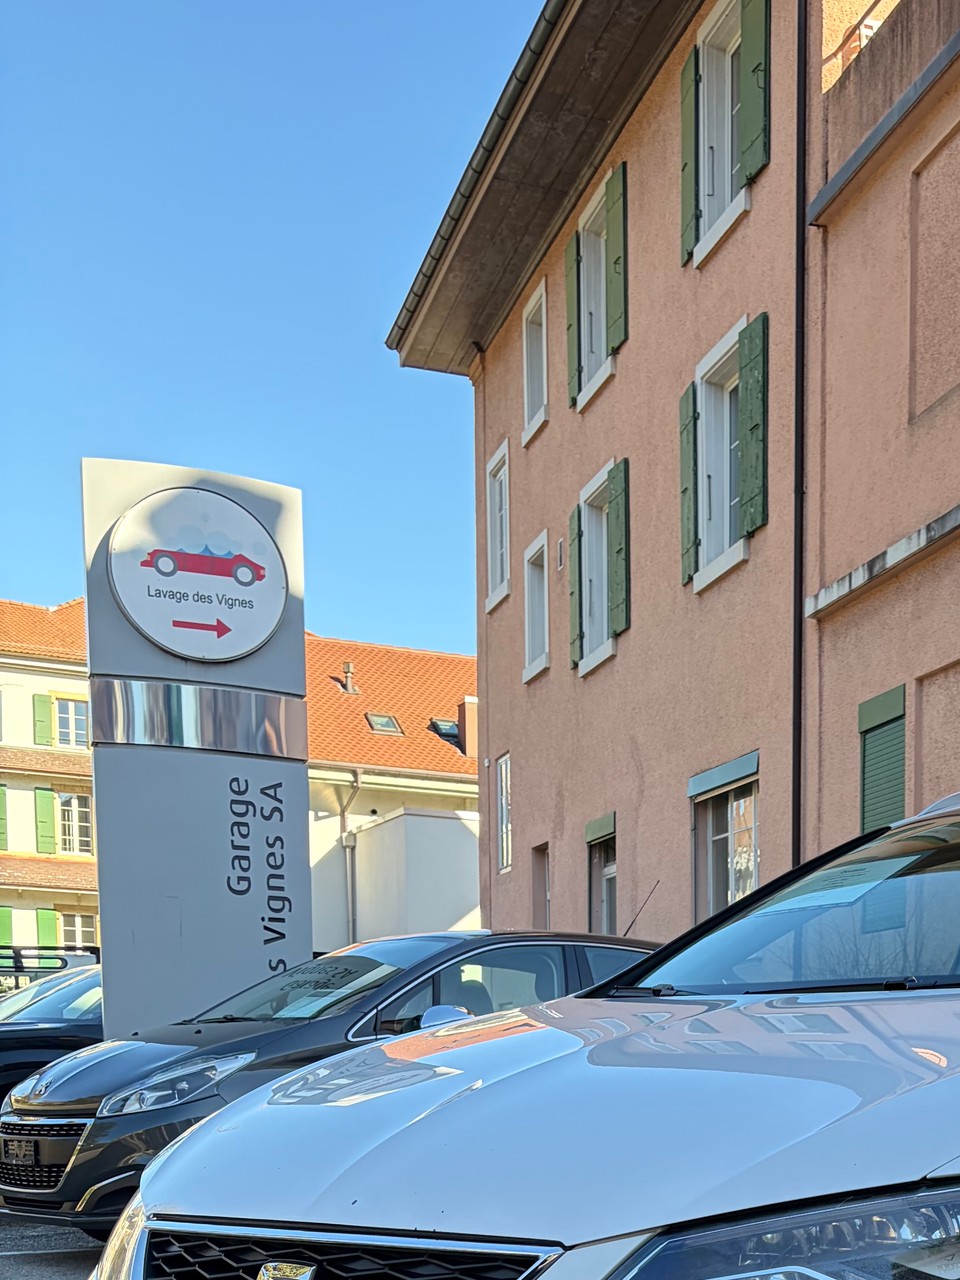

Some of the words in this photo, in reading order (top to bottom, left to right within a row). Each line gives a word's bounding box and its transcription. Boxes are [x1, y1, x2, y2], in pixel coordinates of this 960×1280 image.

[147, 585, 189, 603] Lavage
[192, 591, 213, 604] des
[216, 593, 254, 609] Vignes
[227, 776, 256, 895] Garage
[260, 782, 284, 822] SA
[261, 835, 292, 945] Vignes
